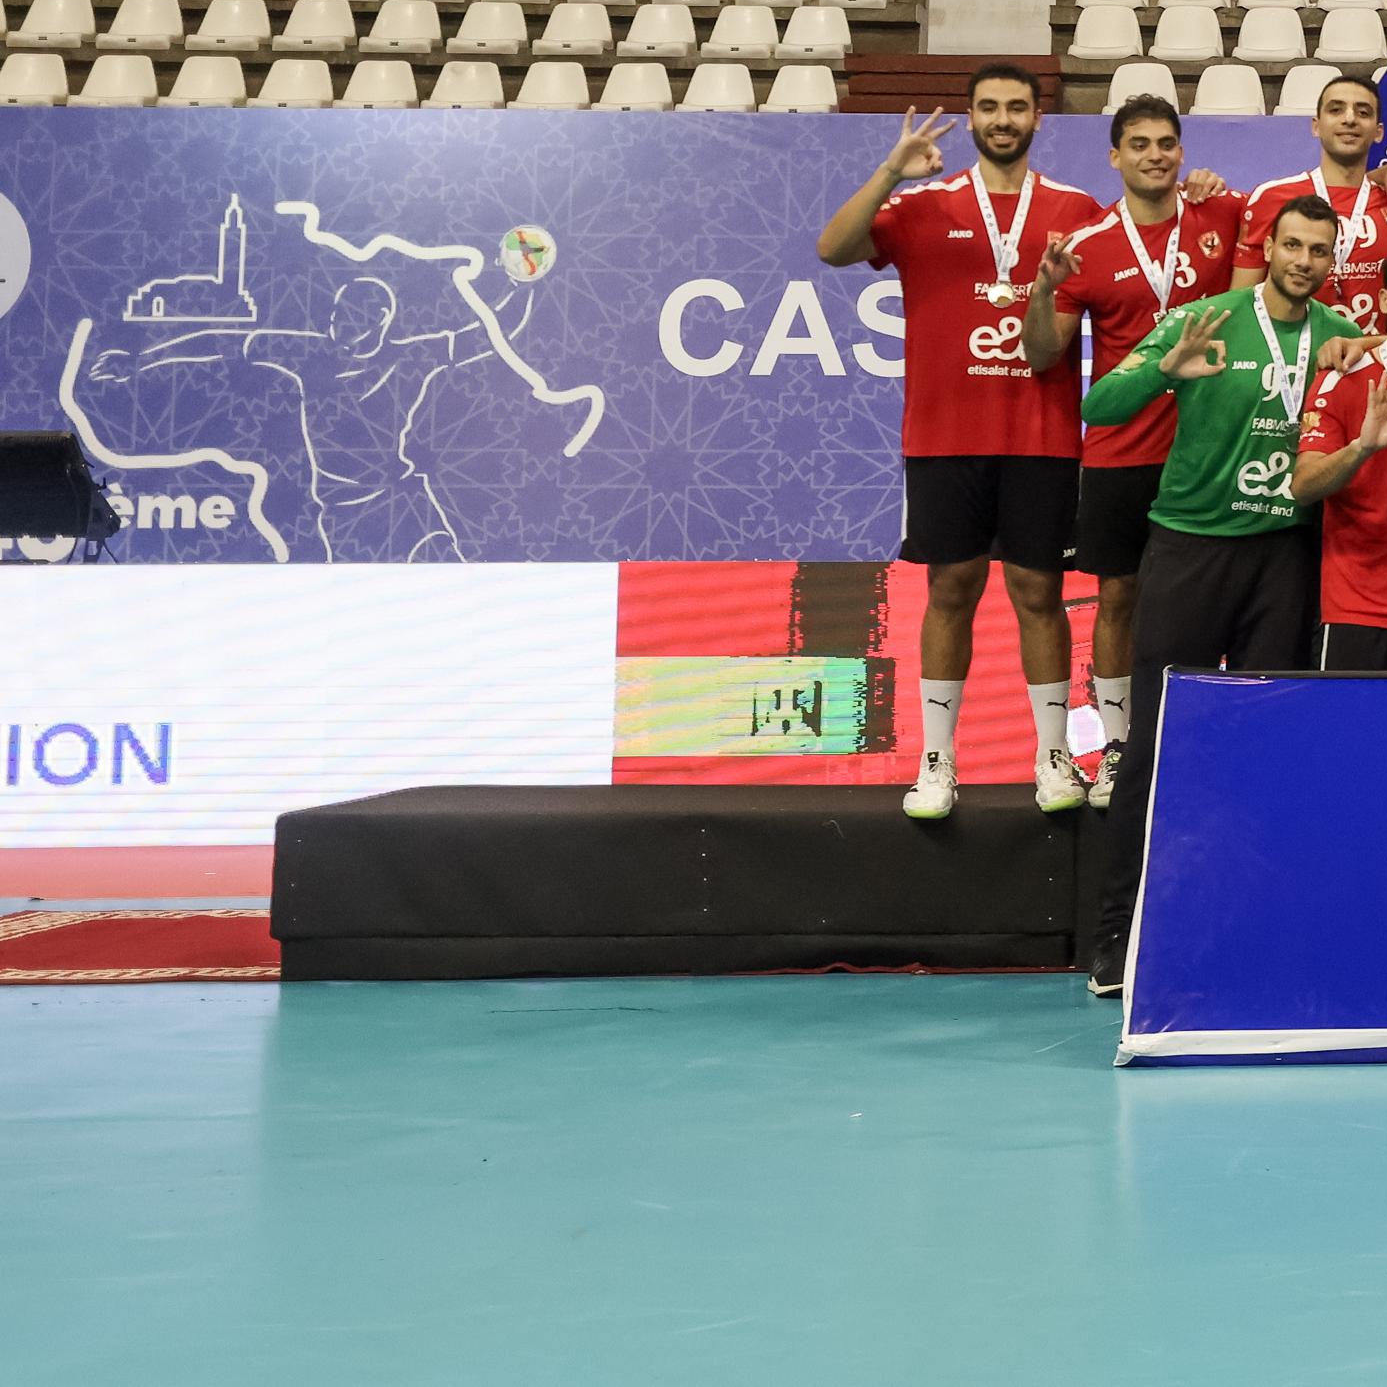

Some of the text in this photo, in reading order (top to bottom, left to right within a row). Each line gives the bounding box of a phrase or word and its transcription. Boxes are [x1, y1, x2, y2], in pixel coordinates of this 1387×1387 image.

[947, 229, 974, 239] JAKO
[1113, 266, 1139, 282] JAKO
[967, 364, 1032, 378] etisalat and
[1231, 361, 1258, 370] JAKO
[1252, 417, 1290, 432] FABMIS
[1270, 504, 1295, 517] and
